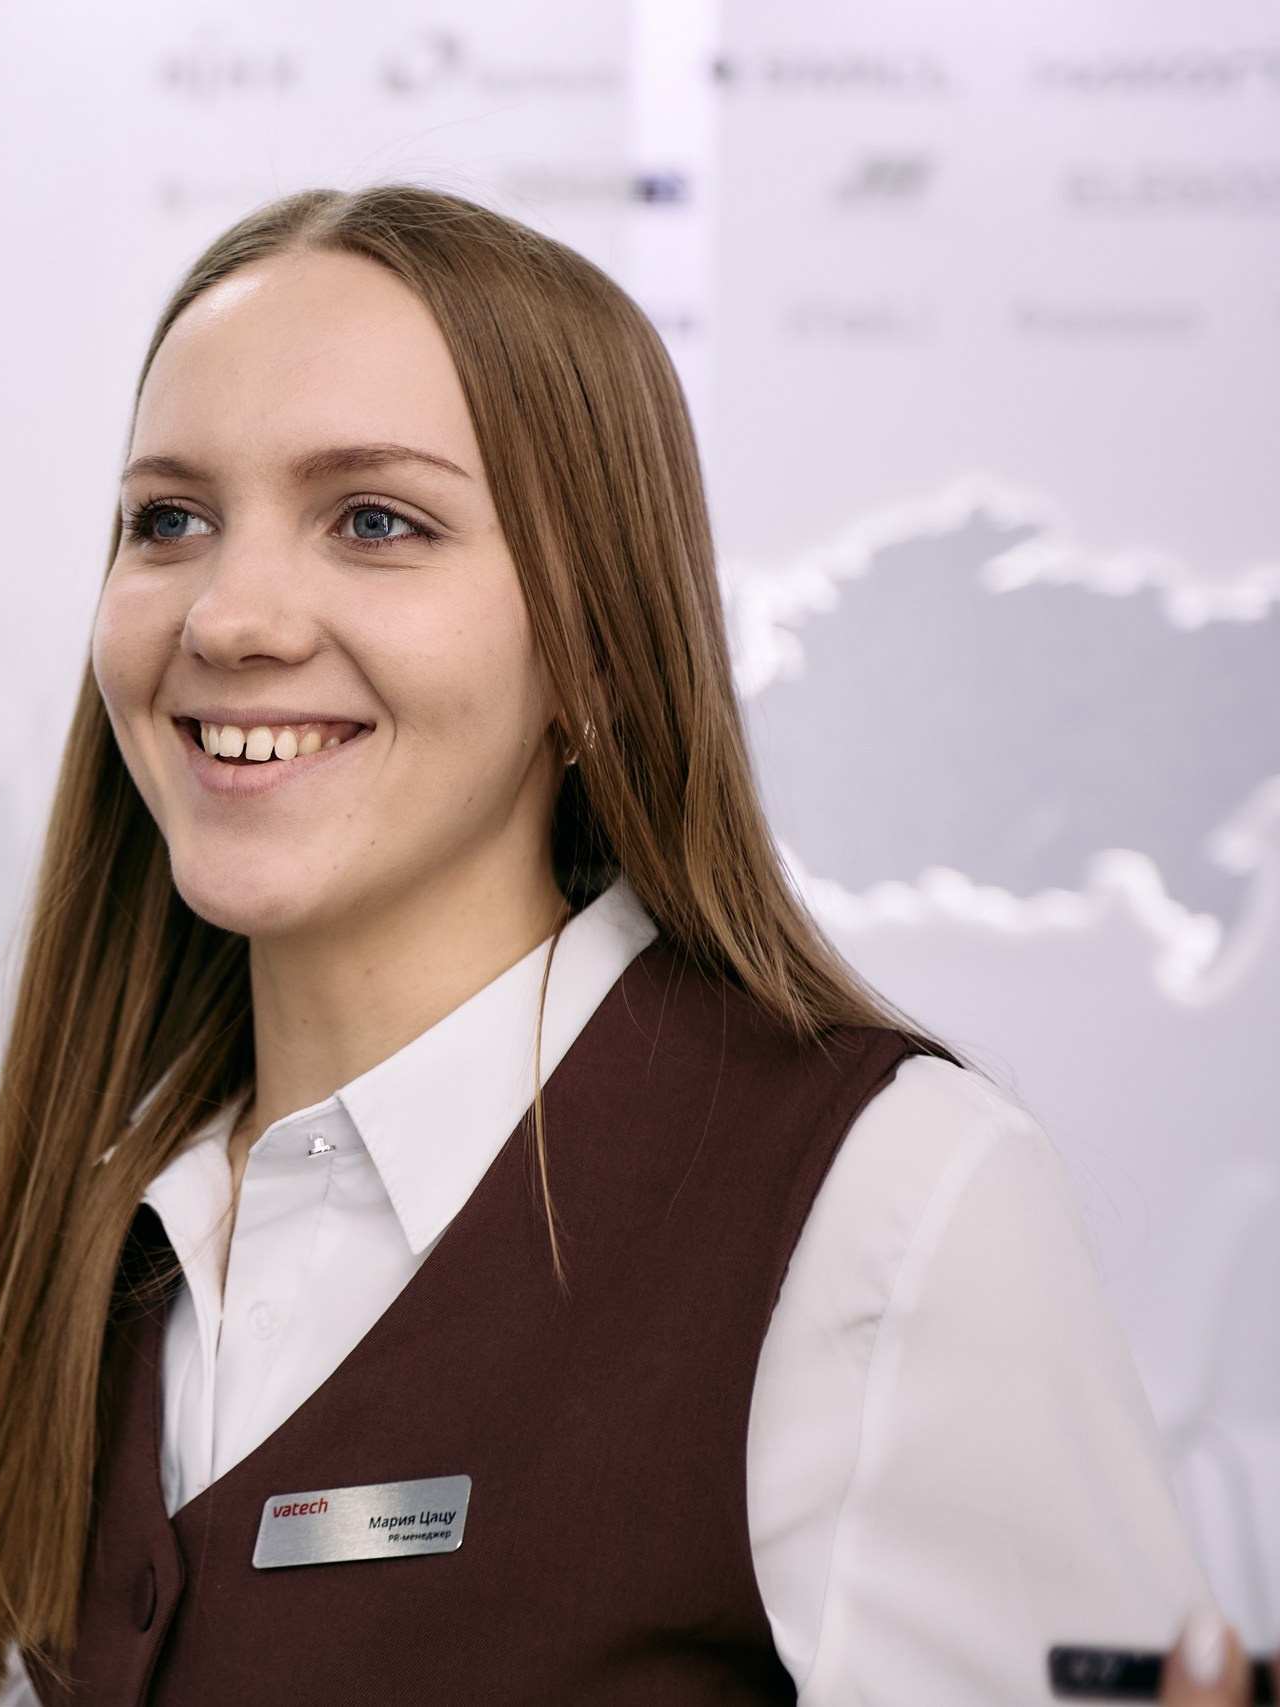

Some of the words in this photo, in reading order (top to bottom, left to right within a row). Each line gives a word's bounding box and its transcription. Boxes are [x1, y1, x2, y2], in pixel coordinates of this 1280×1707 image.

[273, 1498, 328, 1518] vatech
[369, 1515, 415, 1531] Мария
[419, 1511, 456, 1527] Цацу
[388, 1530, 451, 1543] PR-менеджер
